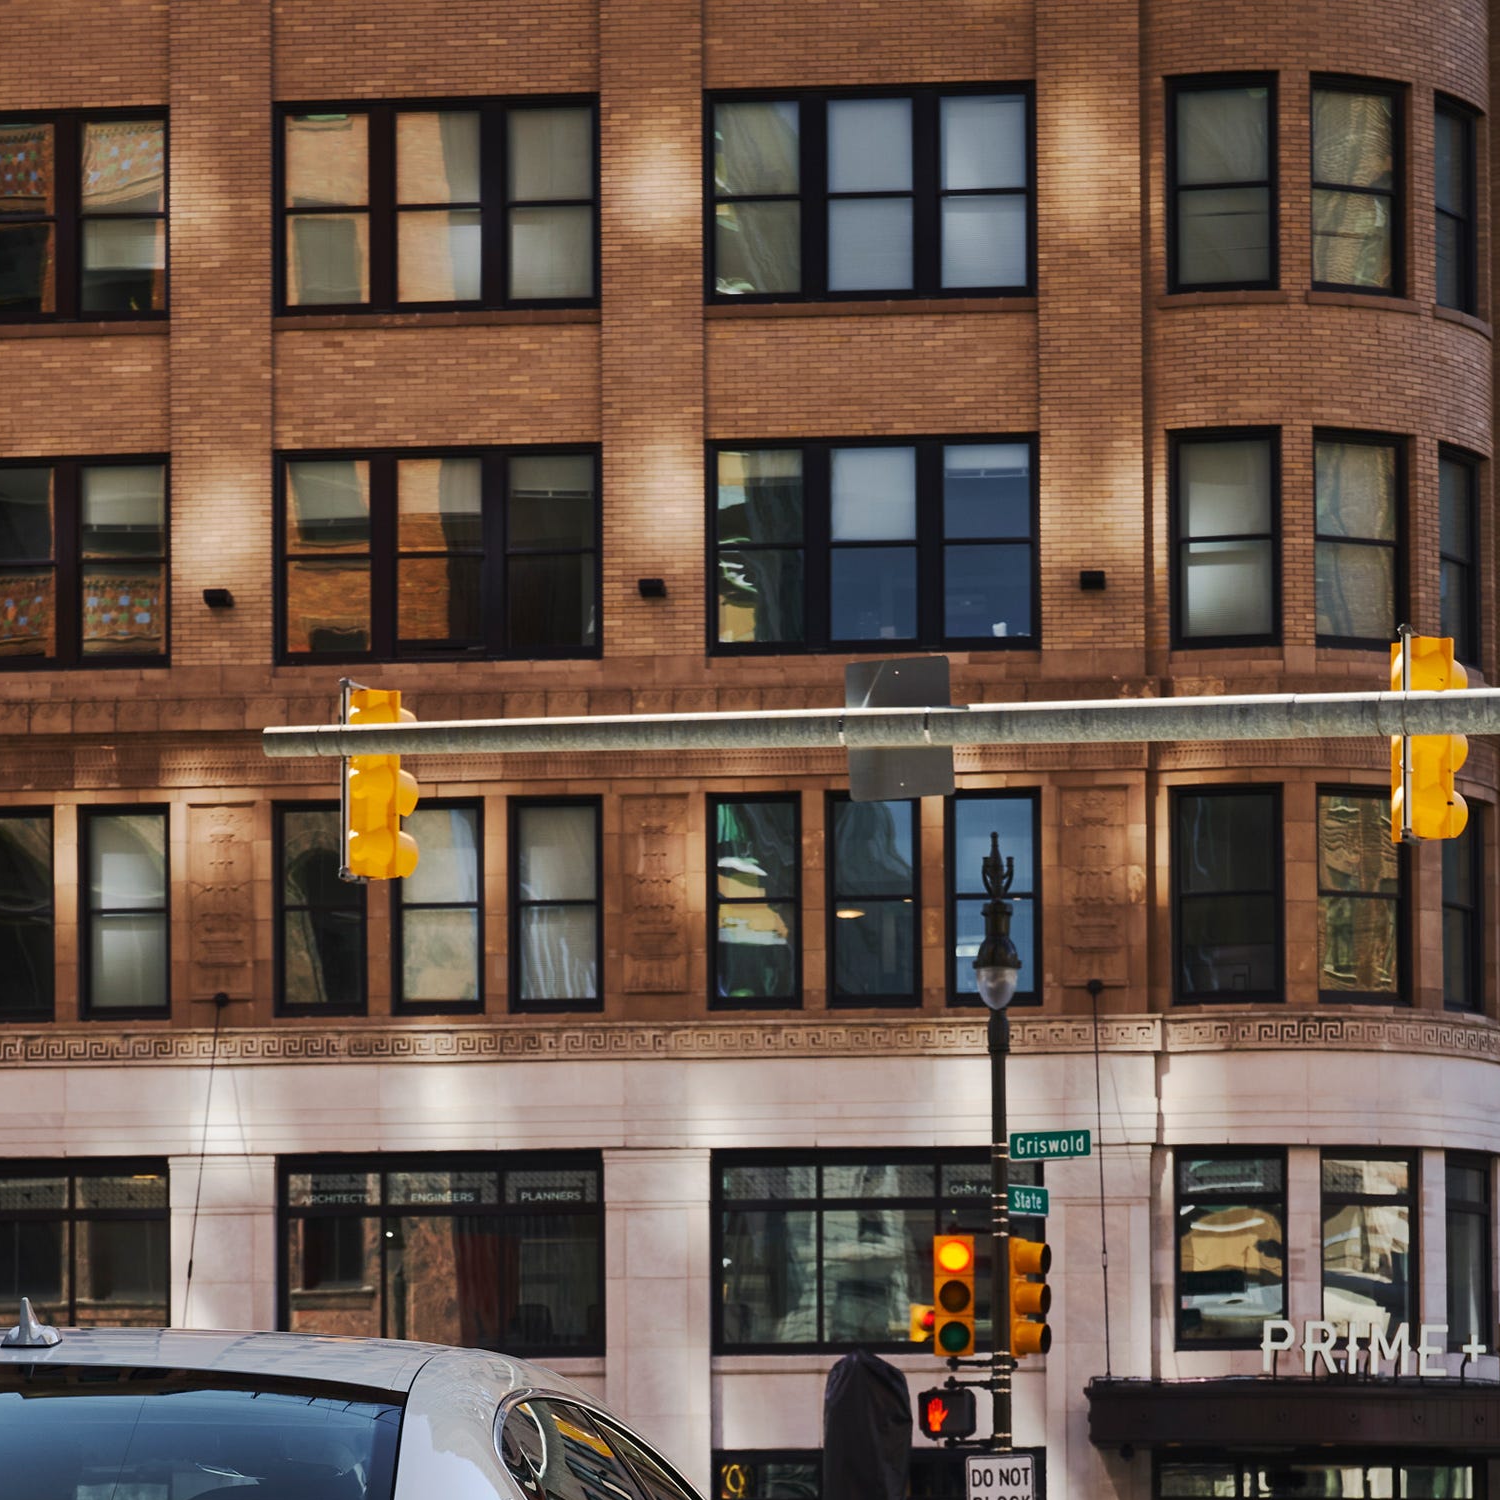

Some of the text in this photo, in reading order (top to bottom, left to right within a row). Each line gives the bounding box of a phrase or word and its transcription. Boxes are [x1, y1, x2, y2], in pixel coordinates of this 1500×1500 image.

[1016, 1135, 1084, 1155] Griswold
[301, 1191, 581, 1204] ARCHITECTS ENGINEERS PLANNERS
[951, 1184, 977, 1195] OHM
[1014, 1191, 1042, 1210] State
[1261, 1319, 1449, 1378] PRIME
[972, 1467, 1030, 1487] DO NOT
